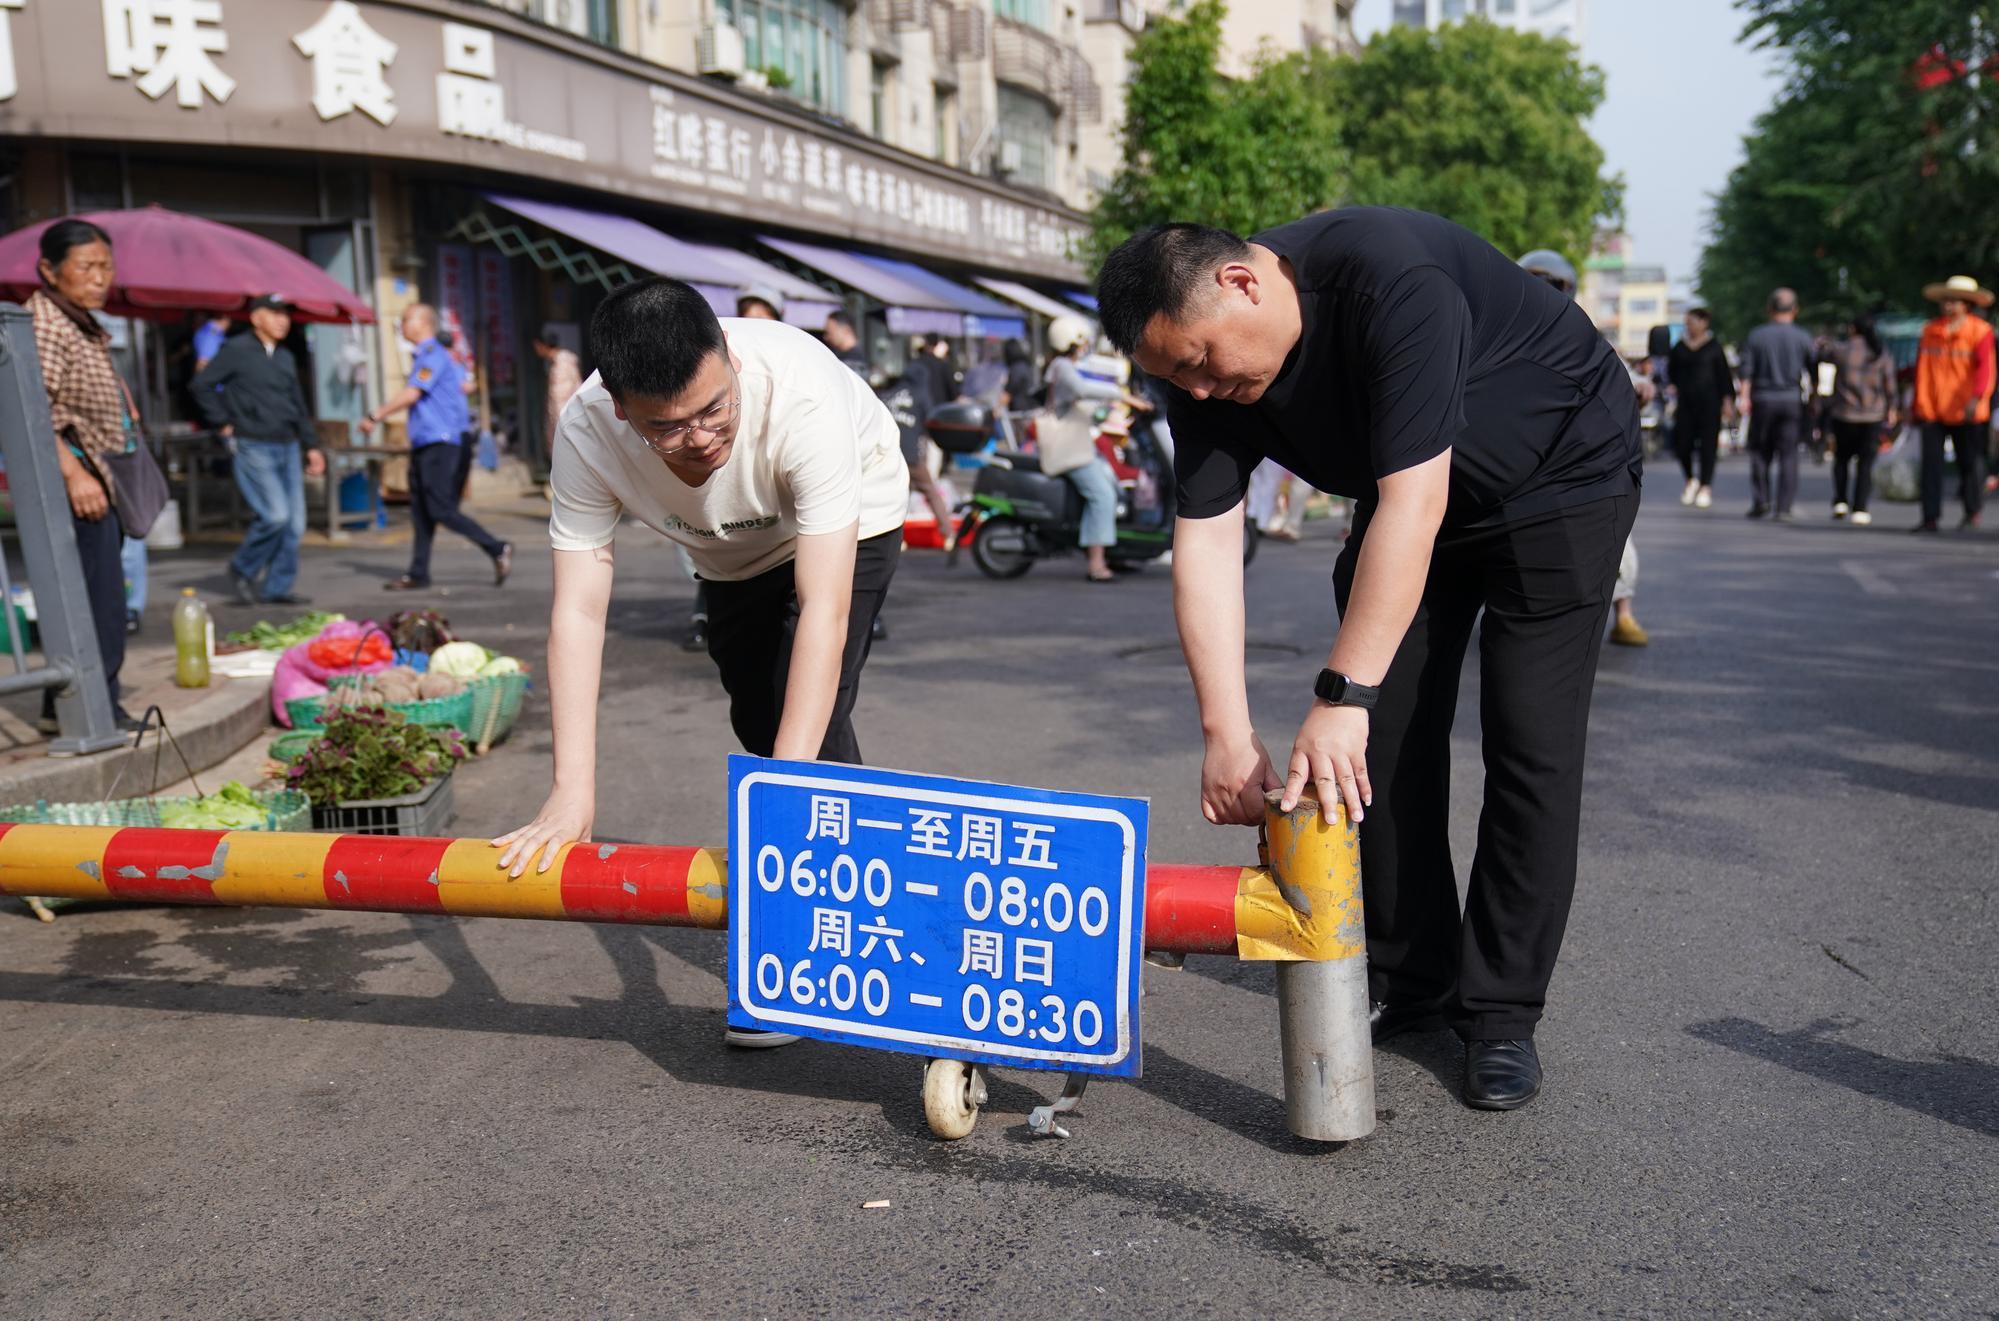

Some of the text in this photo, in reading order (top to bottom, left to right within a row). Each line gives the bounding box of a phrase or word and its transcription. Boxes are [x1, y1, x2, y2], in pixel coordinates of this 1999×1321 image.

[0, 0, 503, 142] 味食品
[806, 795, 1058, 869] 周一至周五
[757, 845, 892, 907] 06:00
[964, 872, 1109, 937] 08:00
[756, 953, 890, 1017] 06:00
[962, 984, 1103, 1047] 08:30
